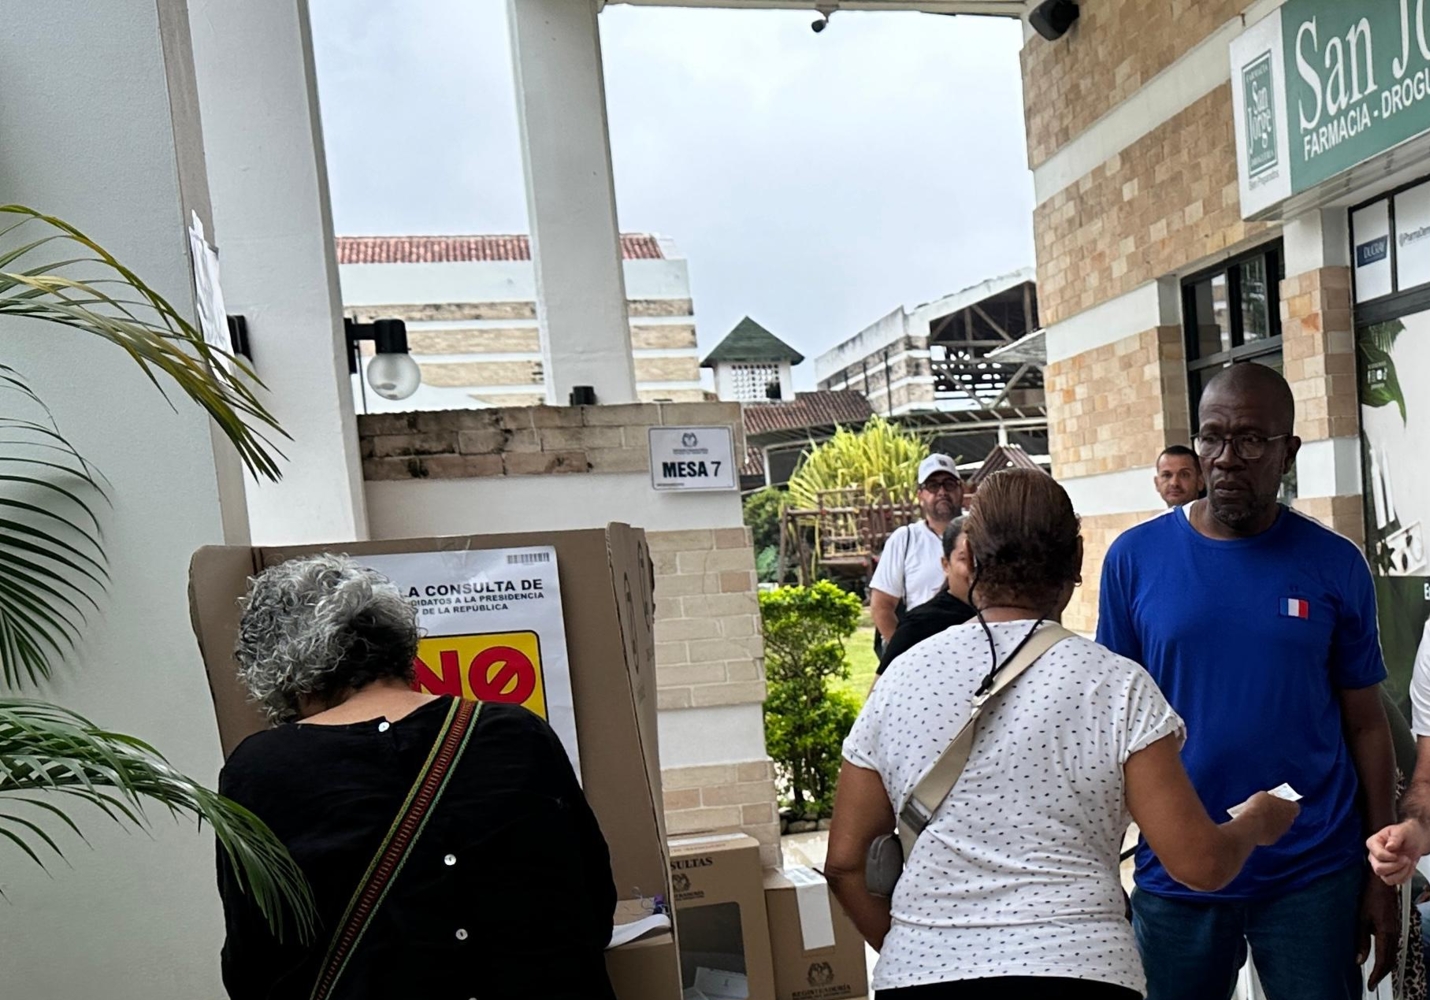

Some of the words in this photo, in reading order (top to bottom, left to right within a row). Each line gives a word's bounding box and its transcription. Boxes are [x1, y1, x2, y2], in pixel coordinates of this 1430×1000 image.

[1296, 16, 1378, 134] San
[1250, 80, 1269, 115] San
[1246, 107, 1272, 156] Jorge
[1303, 102, 1371, 161] FARMACIA
[662, 461, 708, 478] MESA
[711, 461, 721, 477] 7
[425, 580, 516, 597] CONSULTA
[521, 579, 543, 591] DE
[465, 594, 476, 603] LA
[479, 592, 544, 602] PRESIDENCIA
[453, 603, 508, 613] REPÚBLICA
[670, 857, 713, 870] SULTAS
